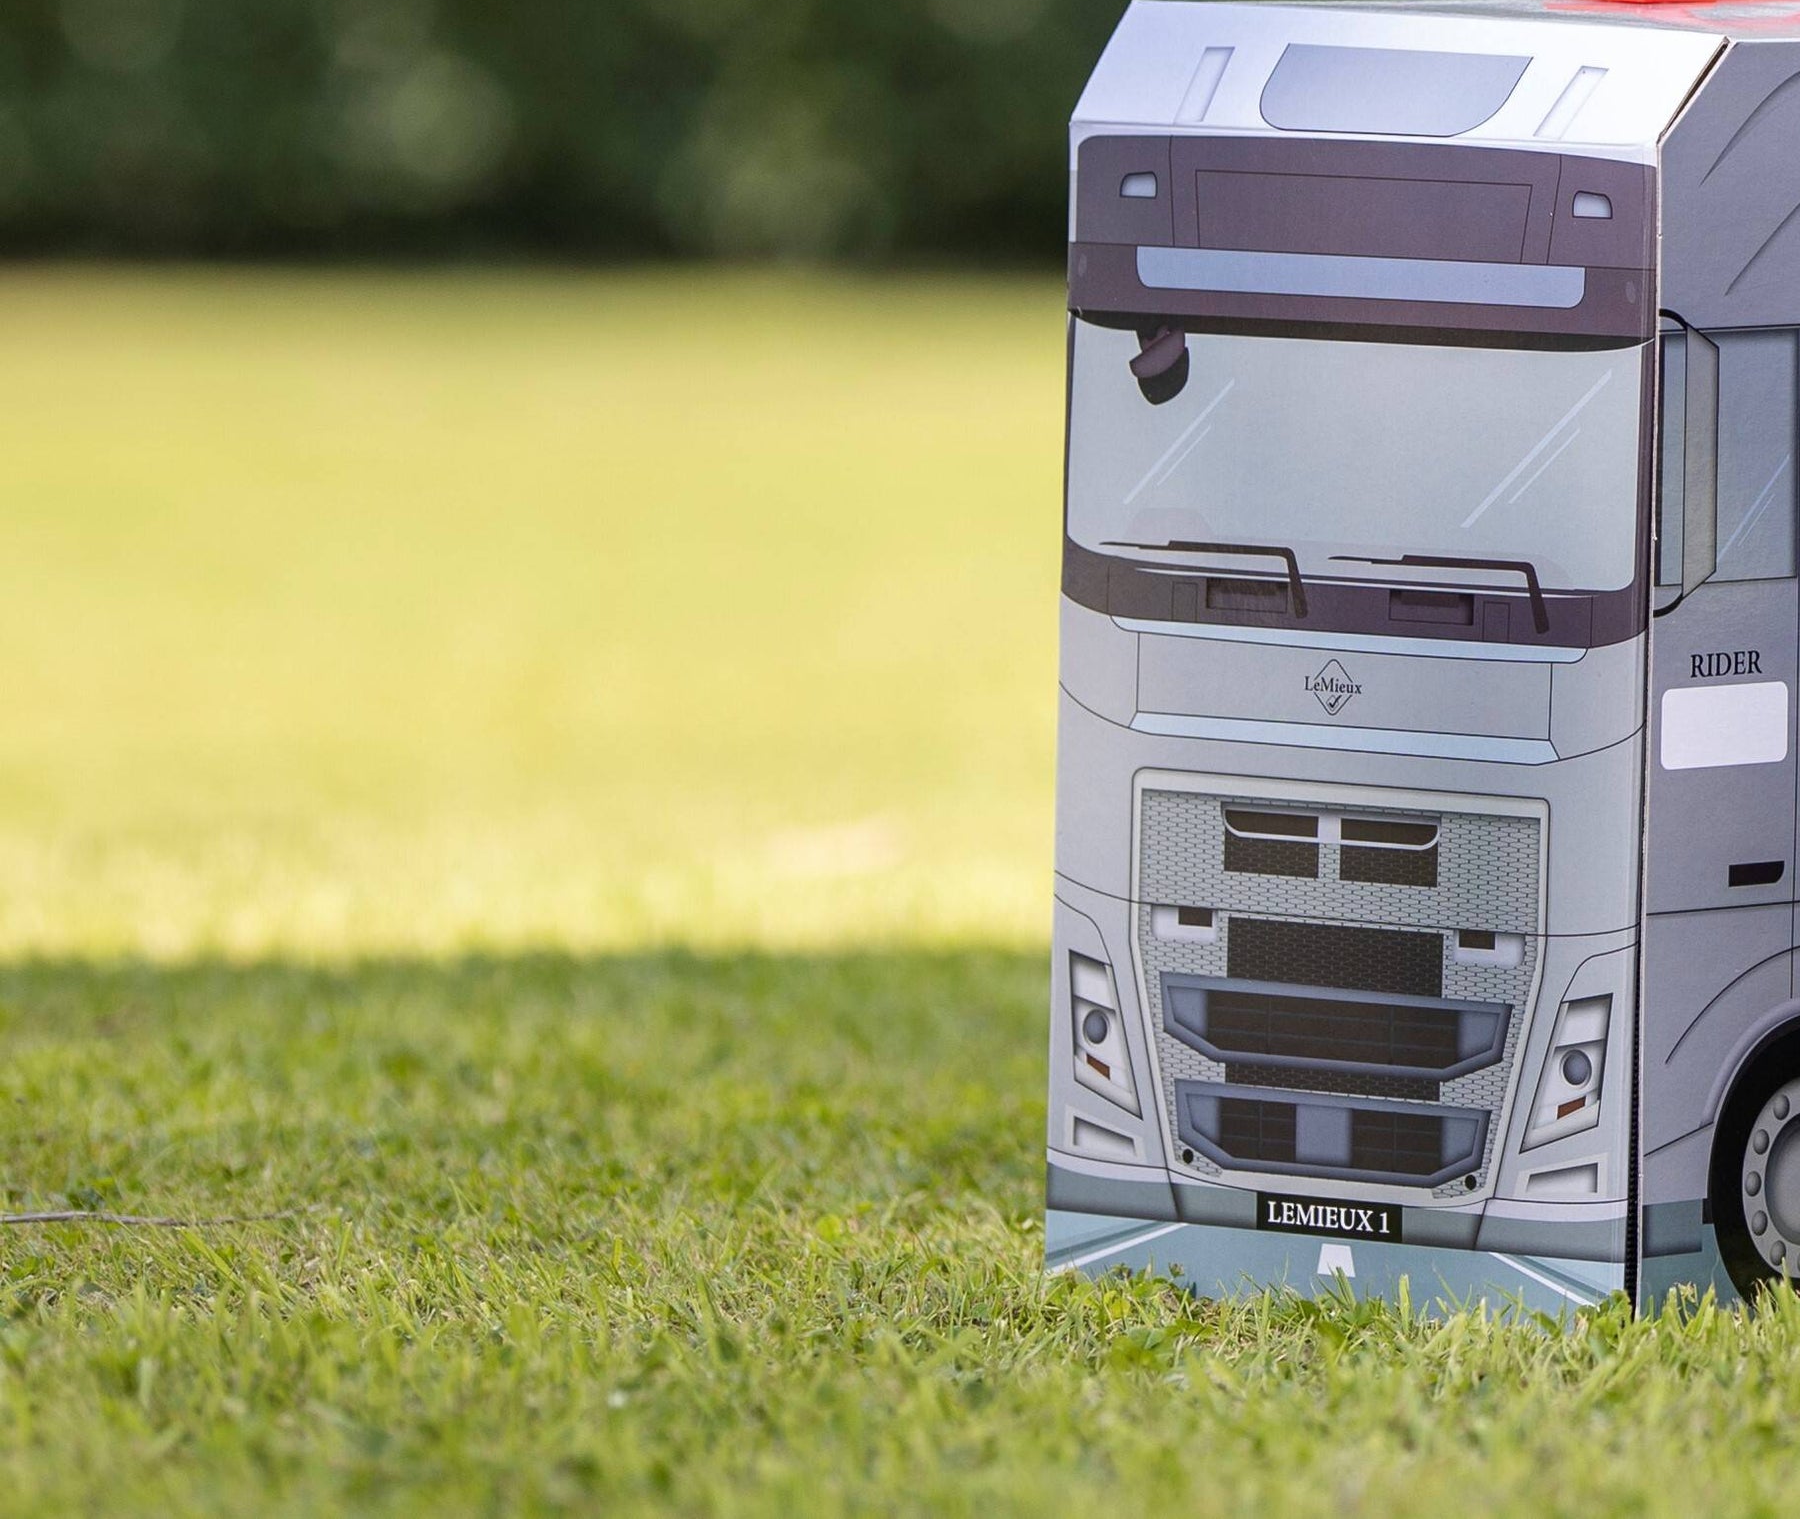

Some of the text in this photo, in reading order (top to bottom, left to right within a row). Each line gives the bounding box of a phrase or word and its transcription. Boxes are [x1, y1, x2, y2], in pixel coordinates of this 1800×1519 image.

[1690, 650, 1763, 679] RIDER
[1304, 675, 1363, 695] LeMieux
[1267, 1200, 1391, 1234] LEMIEUX 1
